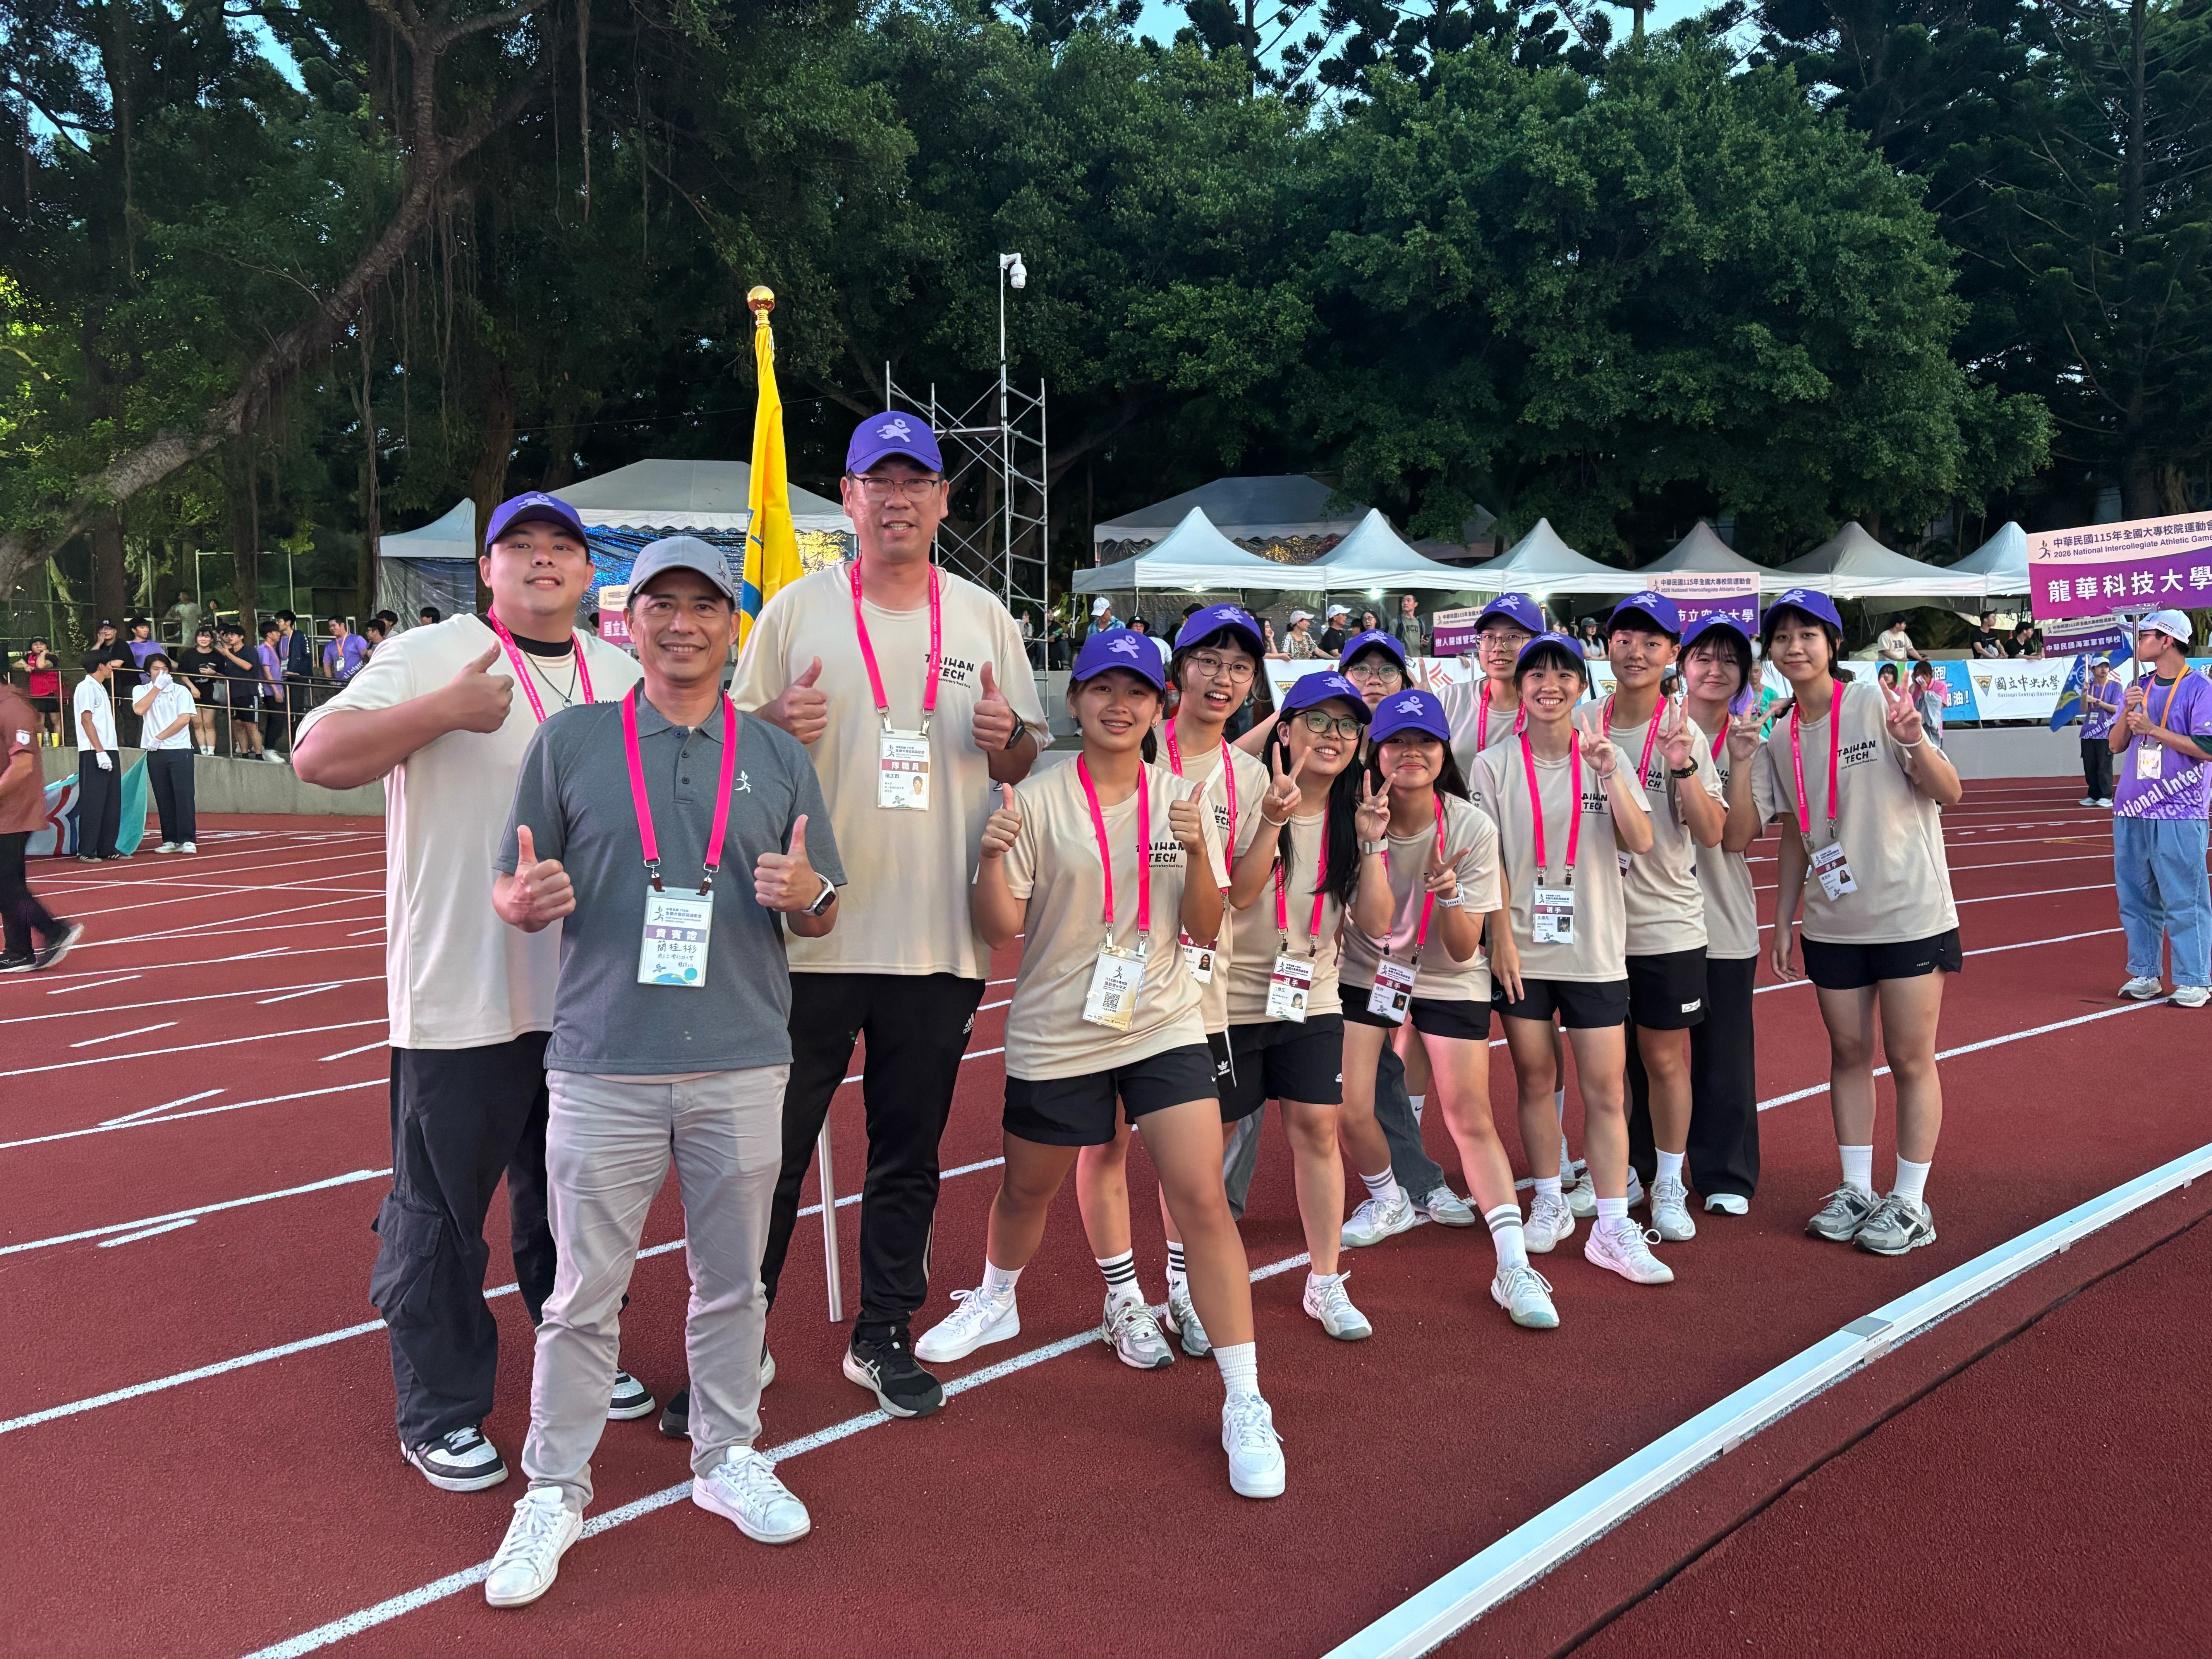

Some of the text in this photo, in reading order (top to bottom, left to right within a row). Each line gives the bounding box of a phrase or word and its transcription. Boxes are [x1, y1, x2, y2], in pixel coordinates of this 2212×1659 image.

[2073, 546, 2103, 556] National
[2105, 541, 2158, 552] Intercollegiate
[2160, 537, 2189, 546] Athletic
[2048, 565, 2212, 603] 龍華科技大學
[1678, 609, 1754, 623] 市立大學
[925, 654, 974, 672] TIWAN
[1994, 674, 2060, 692] 國立中央大學
[1845, 751, 1869, 764] TECH
[891, 761, 919, 771] 隊職員
[656, 928, 697, 941] 貴賓證
[1386, 979, 1400, 989] 選手
